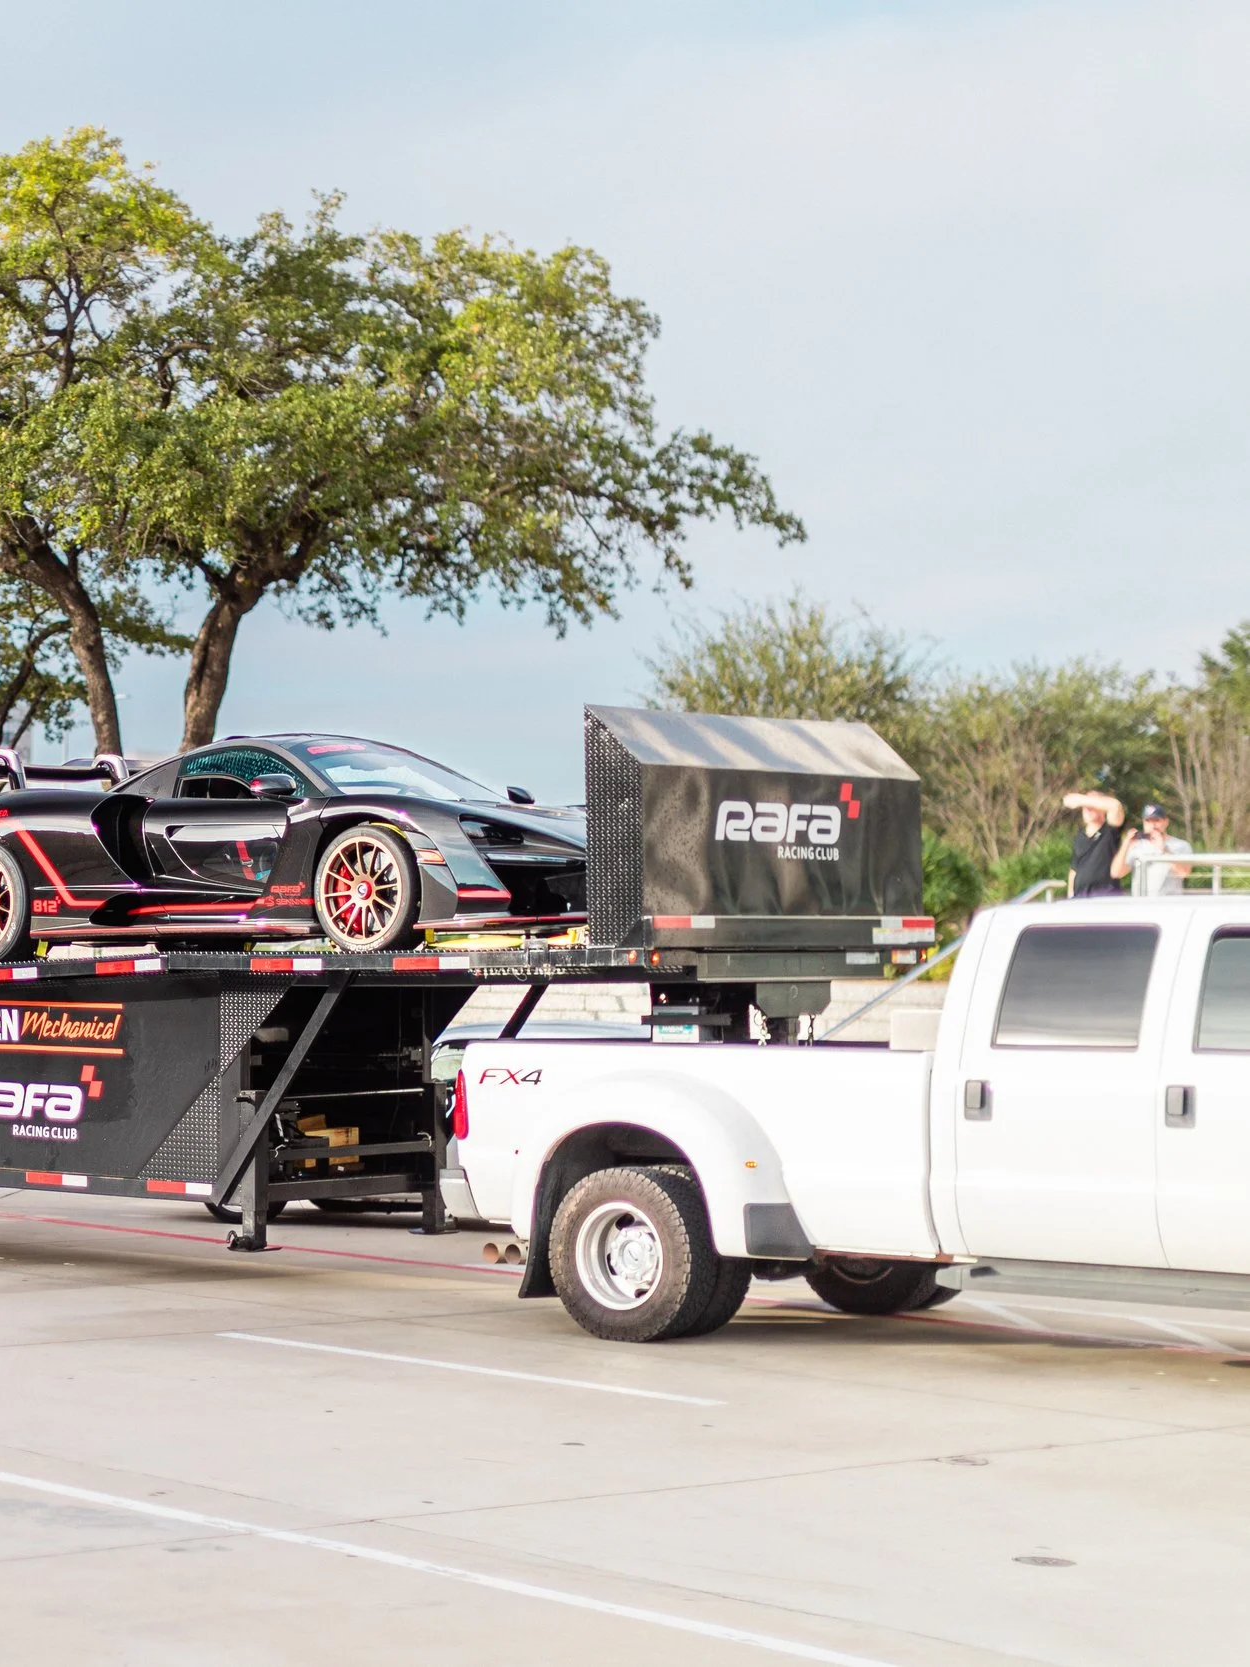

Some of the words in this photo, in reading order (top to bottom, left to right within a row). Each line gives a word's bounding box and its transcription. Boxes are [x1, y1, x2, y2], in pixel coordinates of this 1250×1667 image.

[777, 845, 814, 860] RACING
[815, 846, 840, 861] CLUB
[33, 899, 58, 913] 812
[21, 1010, 122, 1041] Mechanical
[479, 1068, 543, 1085] FX4
[12, 1124, 50, 1139] RACING
[51, 1126, 78, 1140] CLUB
